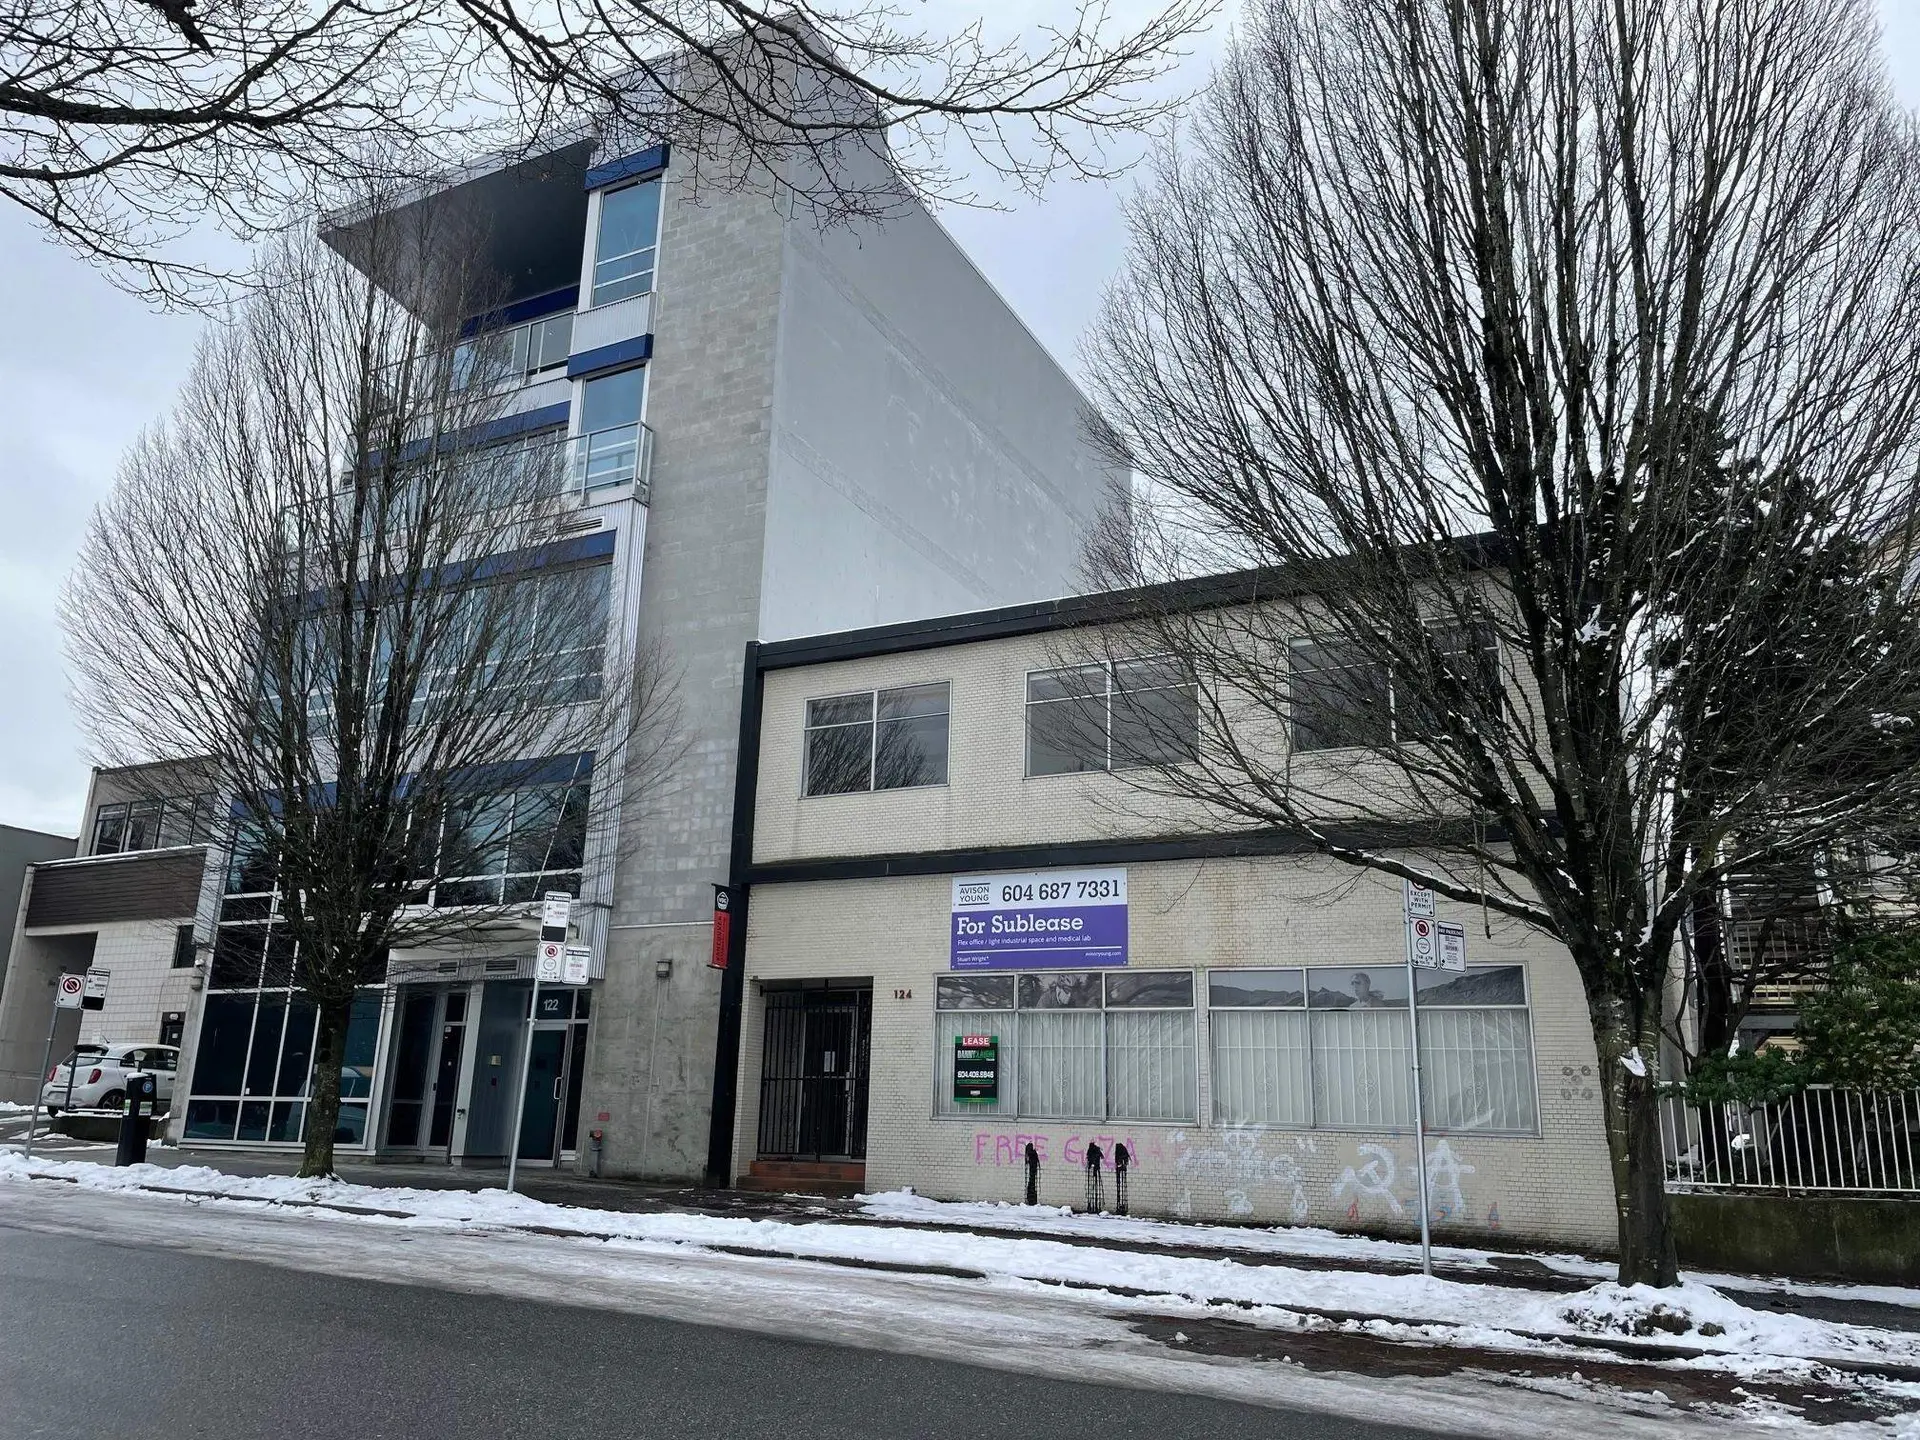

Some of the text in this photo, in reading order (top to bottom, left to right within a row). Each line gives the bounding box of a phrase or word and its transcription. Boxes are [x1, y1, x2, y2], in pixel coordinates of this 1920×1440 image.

[960, 886, 990, 895] AVISON
[1002, 880, 1120, 902] 604 687 7331
[1410, 890, 1431, 898] EXCEPT
[960, 894, 990, 902] YOUNG
[1410, 901, 1431, 909] PERMIT
[956, 913, 1084, 935] For Sublease
[969, 938, 985, 946] office
[988, 938, 1001, 947] light
[1001, 936, 1028, 945] industrial
[1028, 936, 1045, 945] space
[1045, 935, 1057, 943] and
[1058, 934, 1081, 942] medical
[1082, 933, 1092, 941] lab
[893, 989, 912, 999] 124
[544, 999, 559, 1011] 122
[962, 1037, 990, 1046] LEASE
[976, 1134, 1050, 1167] FREE
